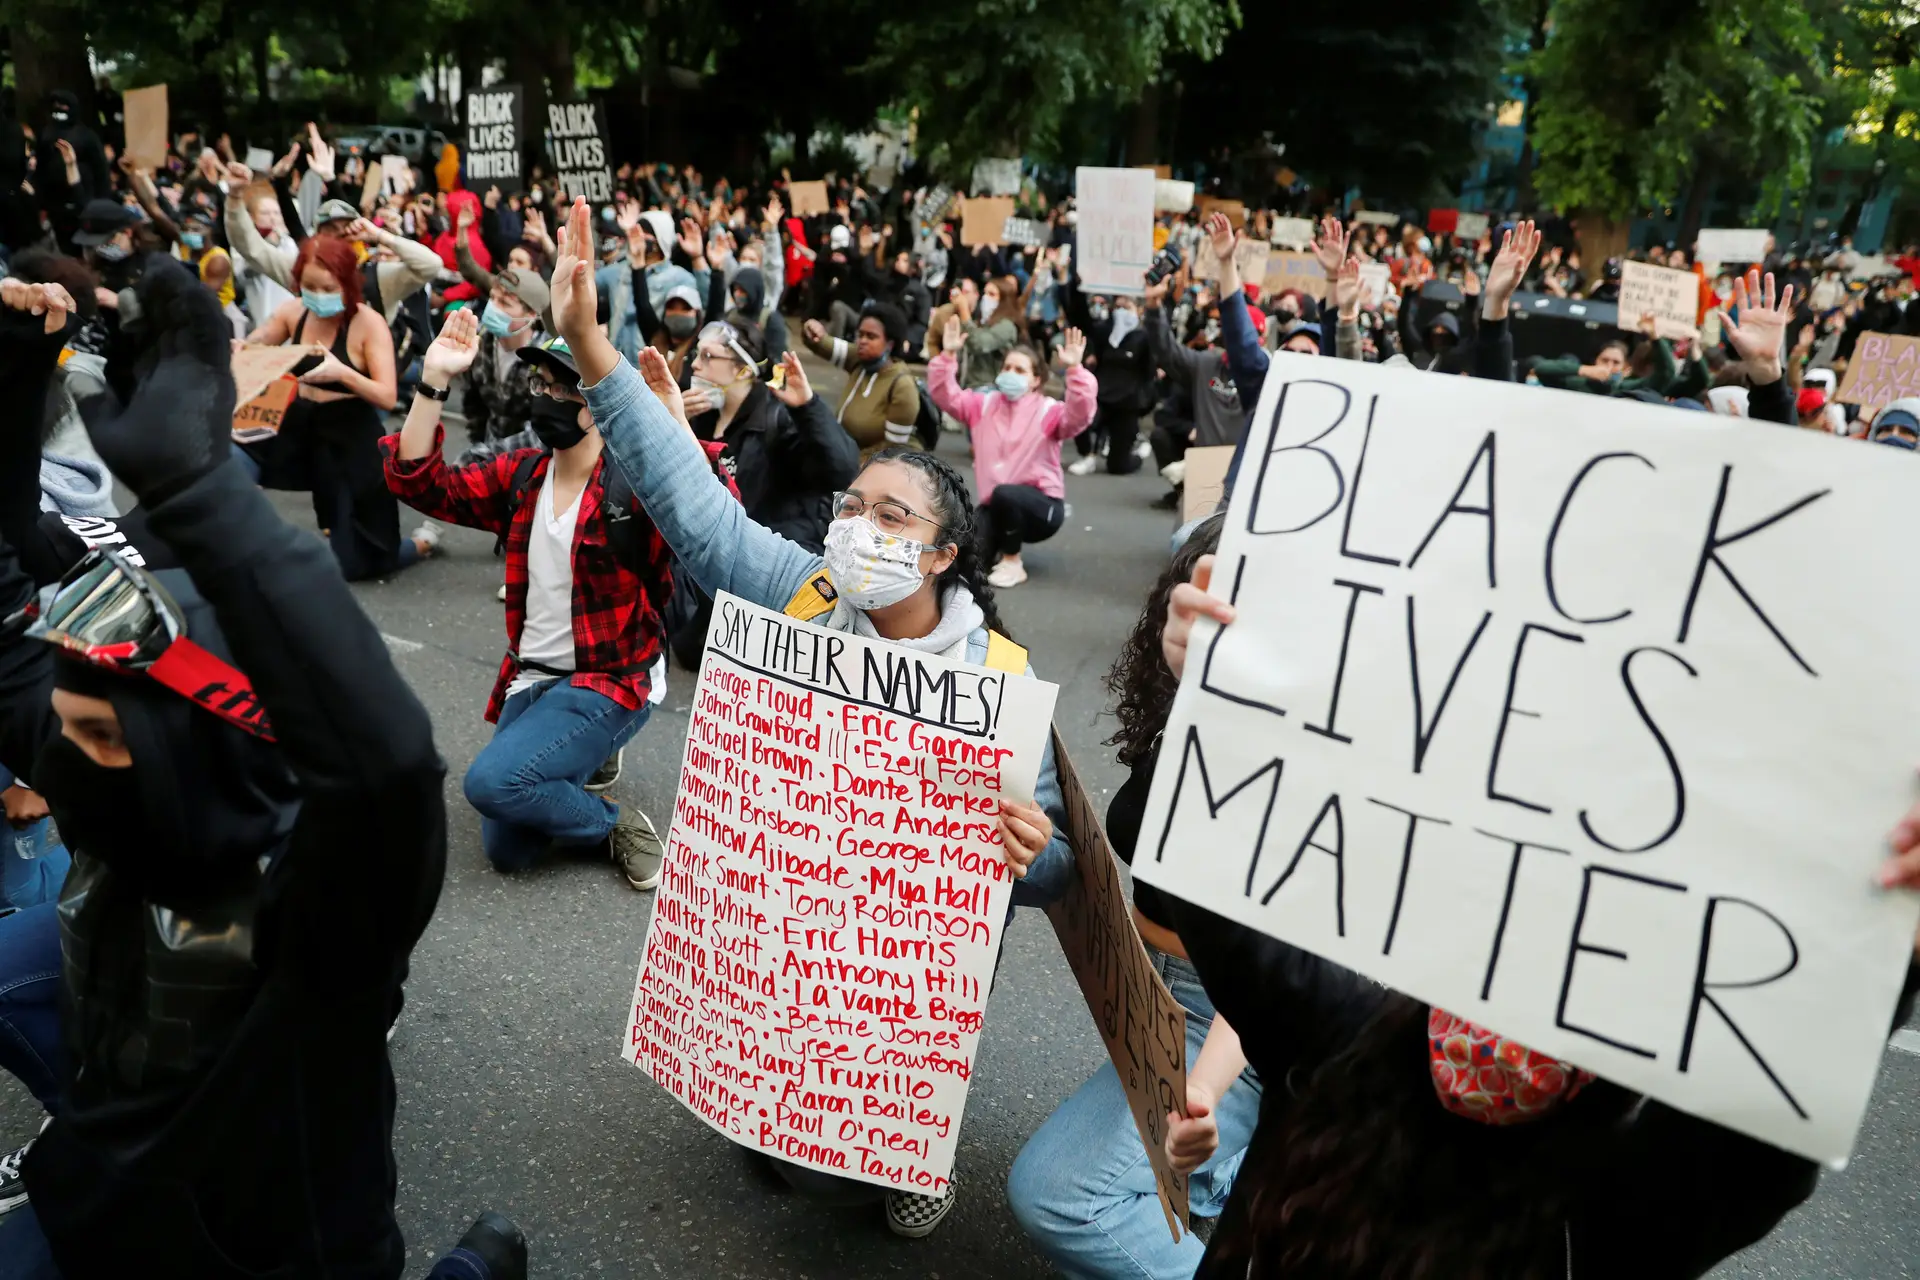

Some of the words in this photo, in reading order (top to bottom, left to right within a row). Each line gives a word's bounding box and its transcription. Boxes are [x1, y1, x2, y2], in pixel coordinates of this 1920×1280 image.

[466, 150, 520, 179] MATTER!
[468, 92, 514, 126] BLACK
[469, 124, 516, 151] LIVES
[548, 104, 598, 138] BLACK
[554, 137, 605, 170] LIVES
[1862, 336, 1920, 367] BLA
[1247, 380, 1831, 676] BLACK
[704, 656, 753, 701] George
[757, 678, 813, 722] Floyd
[842, 704, 898, 742] Eric
[908, 722, 1013, 770] Garner
[714, 601, 754, 659] SAY
[760, 616, 851, 696] THEIR
[863, 646, 1006, 741] NAMES!
[1200, 555, 1698, 853] LIVES
[693, 713, 746, 760] Michael
[752, 737, 813, 780] Brown
[832, 763, 913, 802] Dante
[699, 689, 735, 720] John
[736, 702, 821, 752] Crawford
[864, 739, 928, 782] Ezell
[937, 757, 1001, 792] Ford
[682, 768, 732, 812] Rumain
[740, 796, 820, 843] Brisbon
[836, 827, 935, 873] George
[940, 843, 1016, 882] Mann
[688, 738, 721, 776] Tamir
[724, 757, 762, 796] Rice
[893, 806, 1014, 859] Anderso
[662, 858, 710, 911] Phillip
[713, 888, 769, 934] White
[783, 917, 846, 952] Eric
[858, 927, 956, 967] Harris
[670, 828, 710, 874] Frank
[716, 856, 768, 899] Smart
[782, 877, 846, 929] Tony
[852, 895, 990, 946] Robinson
[678, 797, 746, 854] Matthew
[870, 866, 928, 909] Mya
[934, 875, 990, 917] Hall
[656, 918, 707, 974] Sandra
[714, 950, 776, 1000] Bland
[658, 897, 705, 938] Walter
[710, 920, 762, 965] Scott
[782, 950, 914, 1001] Anthony
[925, 968, 979, 1002] Hill
[1155, 724, 1809, 1121] MATTER
[637, 986, 678, 1024] Jamar
[682, 1012, 727, 1049] Clark
[738, 1039, 806, 1083] Mary
[810, 1058, 934, 1100] Truxillo
[642, 967, 694, 1011] Alonzo
[700, 998, 756, 1042] Smith
[774, 1027, 857, 1062] Tyree
[864, 1043, 971, 1081] Crawford
[648, 939, 684, 981] Kevin
[786, 1003, 872, 1038] Bettie
[880, 1018, 960, 1050] Jones
[632, 1025, 683, 1076] Pamela
[690, 1062, 755, 1116] Turner
[776, 1102, 823, 1138] Paul
[636, 1006, 698, 1060] Demarcus
[705, 1047, 765, 1090] Semer
[781, 1079, 853, 1114] Aaron
[863, 1094, 950, 1138] Bailey
[688, 1084, 740, 1134] Woods
[760, 1122, 850, 1170] Breonna
[854, 1146, 949, 1190] Taylor
